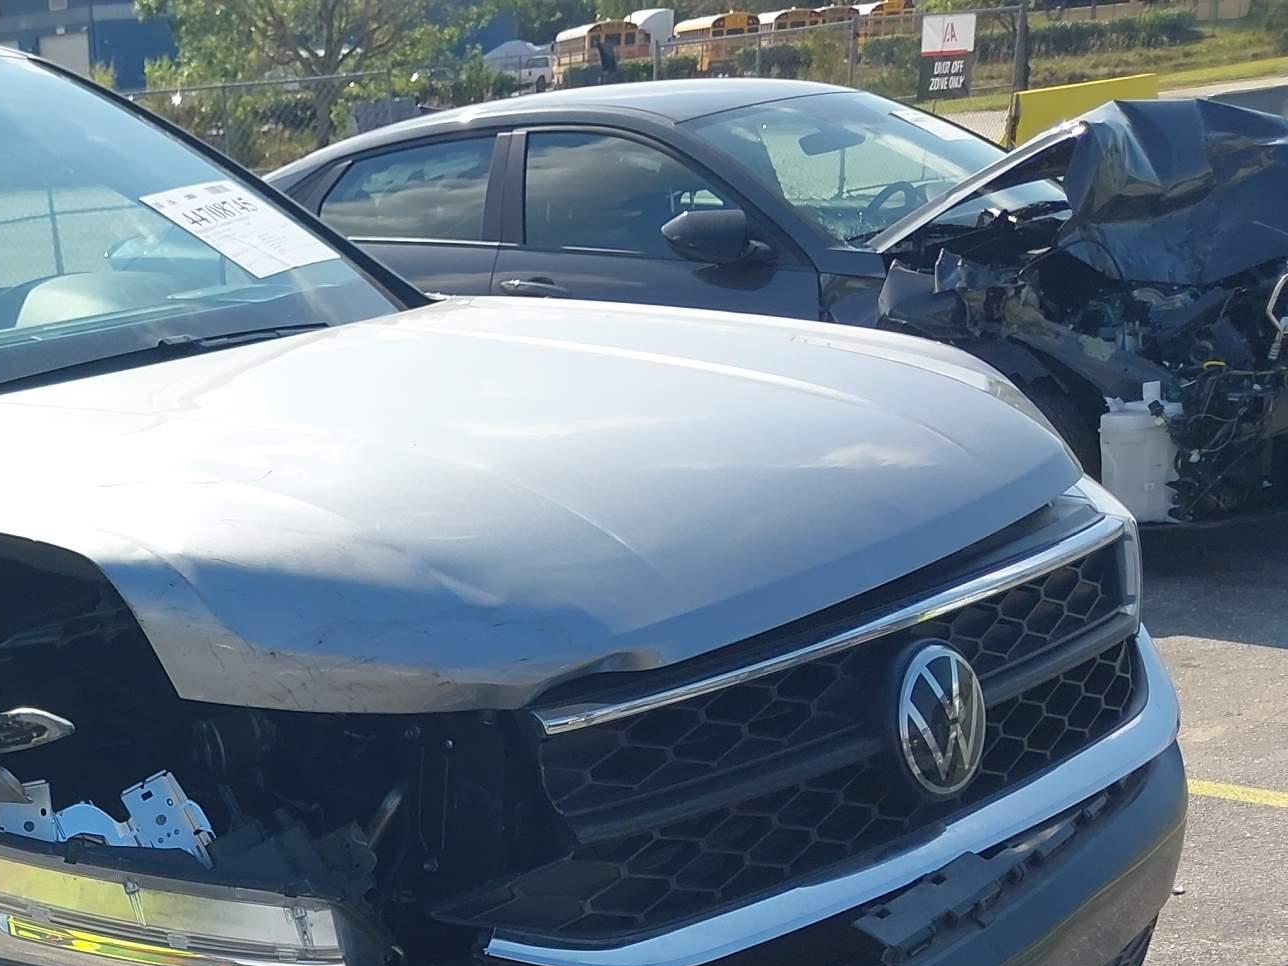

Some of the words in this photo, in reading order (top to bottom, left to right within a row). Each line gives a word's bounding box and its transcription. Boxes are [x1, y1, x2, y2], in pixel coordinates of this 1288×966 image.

[951, 60, 965, 74] OFF
[929, 76, 949, 91] ZONE
[948, 75, 965, 89] ONLY
[181, 197, 258, 227] 44708745
